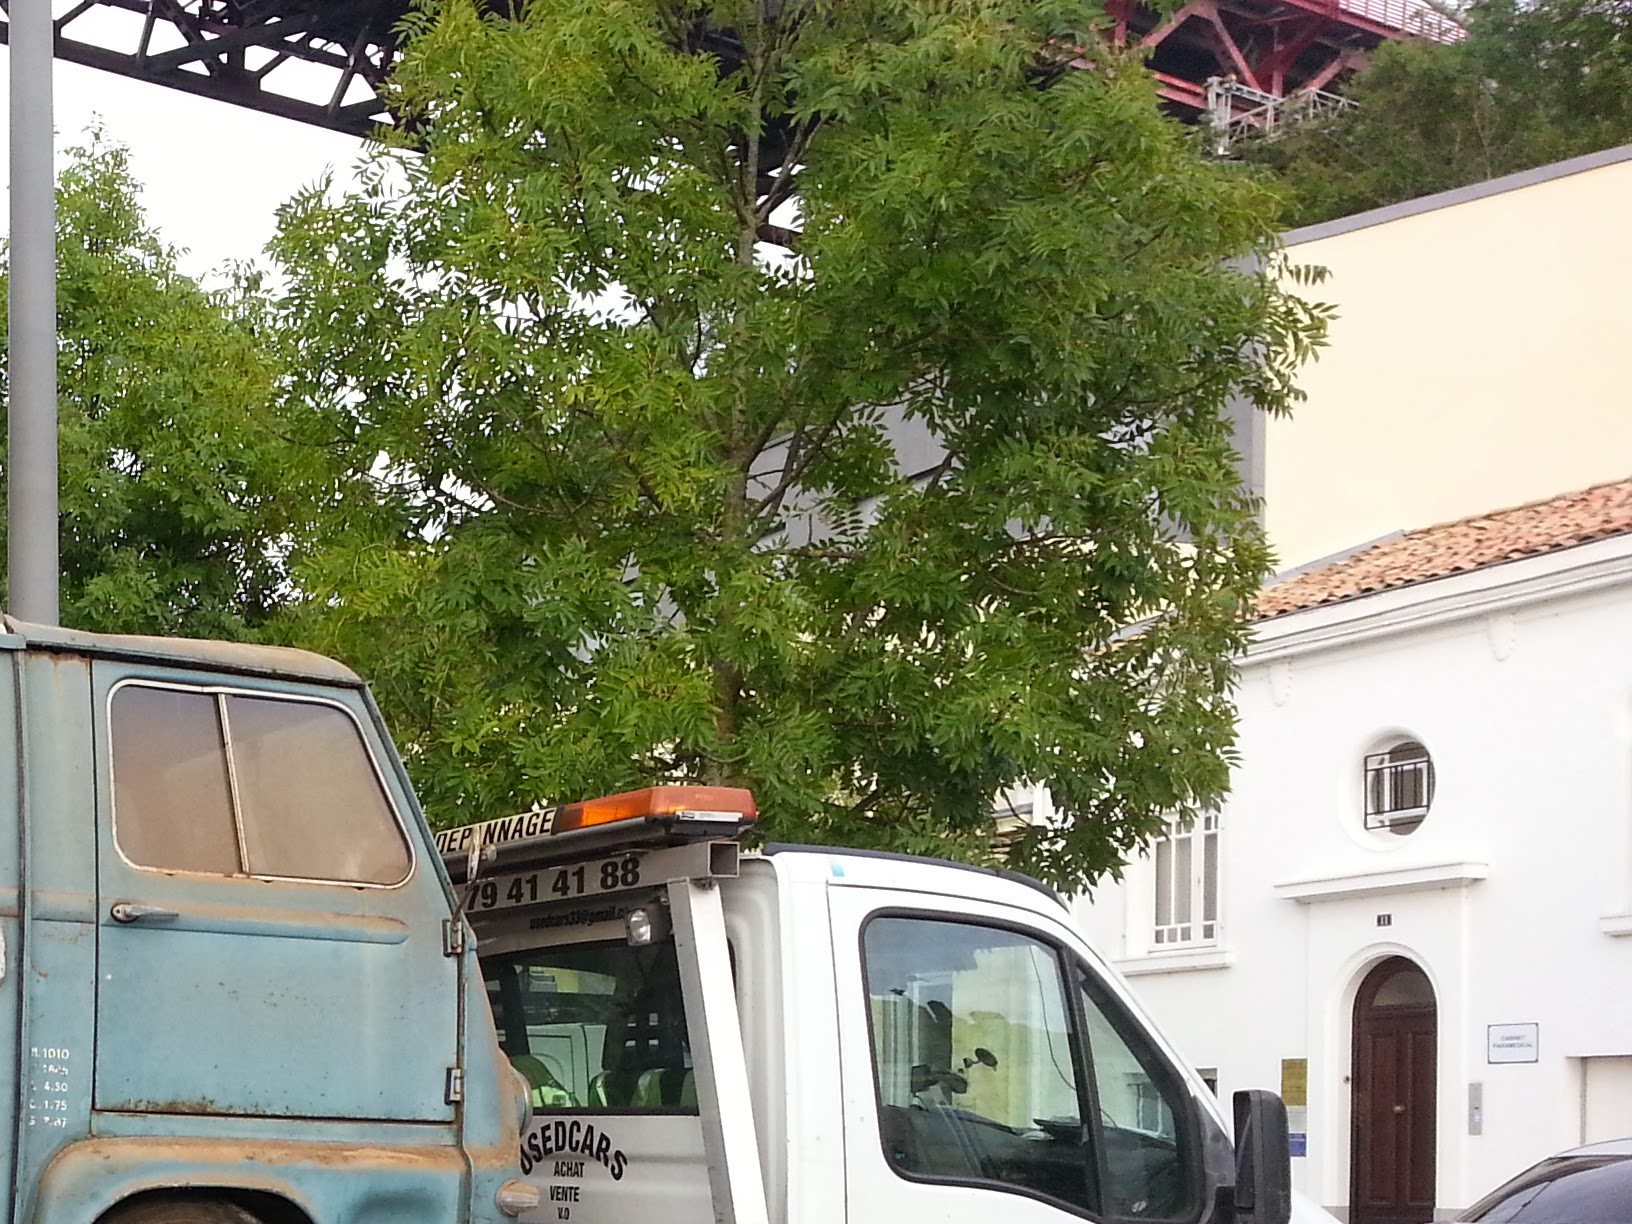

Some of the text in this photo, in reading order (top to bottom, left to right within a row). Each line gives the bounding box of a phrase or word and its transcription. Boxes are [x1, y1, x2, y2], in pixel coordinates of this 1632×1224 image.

[435, 809, 555, 854] DEPNNAGE
[506, 873, 538, 904] 41
[552, 864, 585, 896] 41
[600, 857, 640, 889] 88
[520, 1120, 628, 1181] USEDCARS
[553, 1161, 585, 1178] ACHAT
[550, 1185, 580, 1202] VENTE
[557, 1207, 570, 1220] V.O
